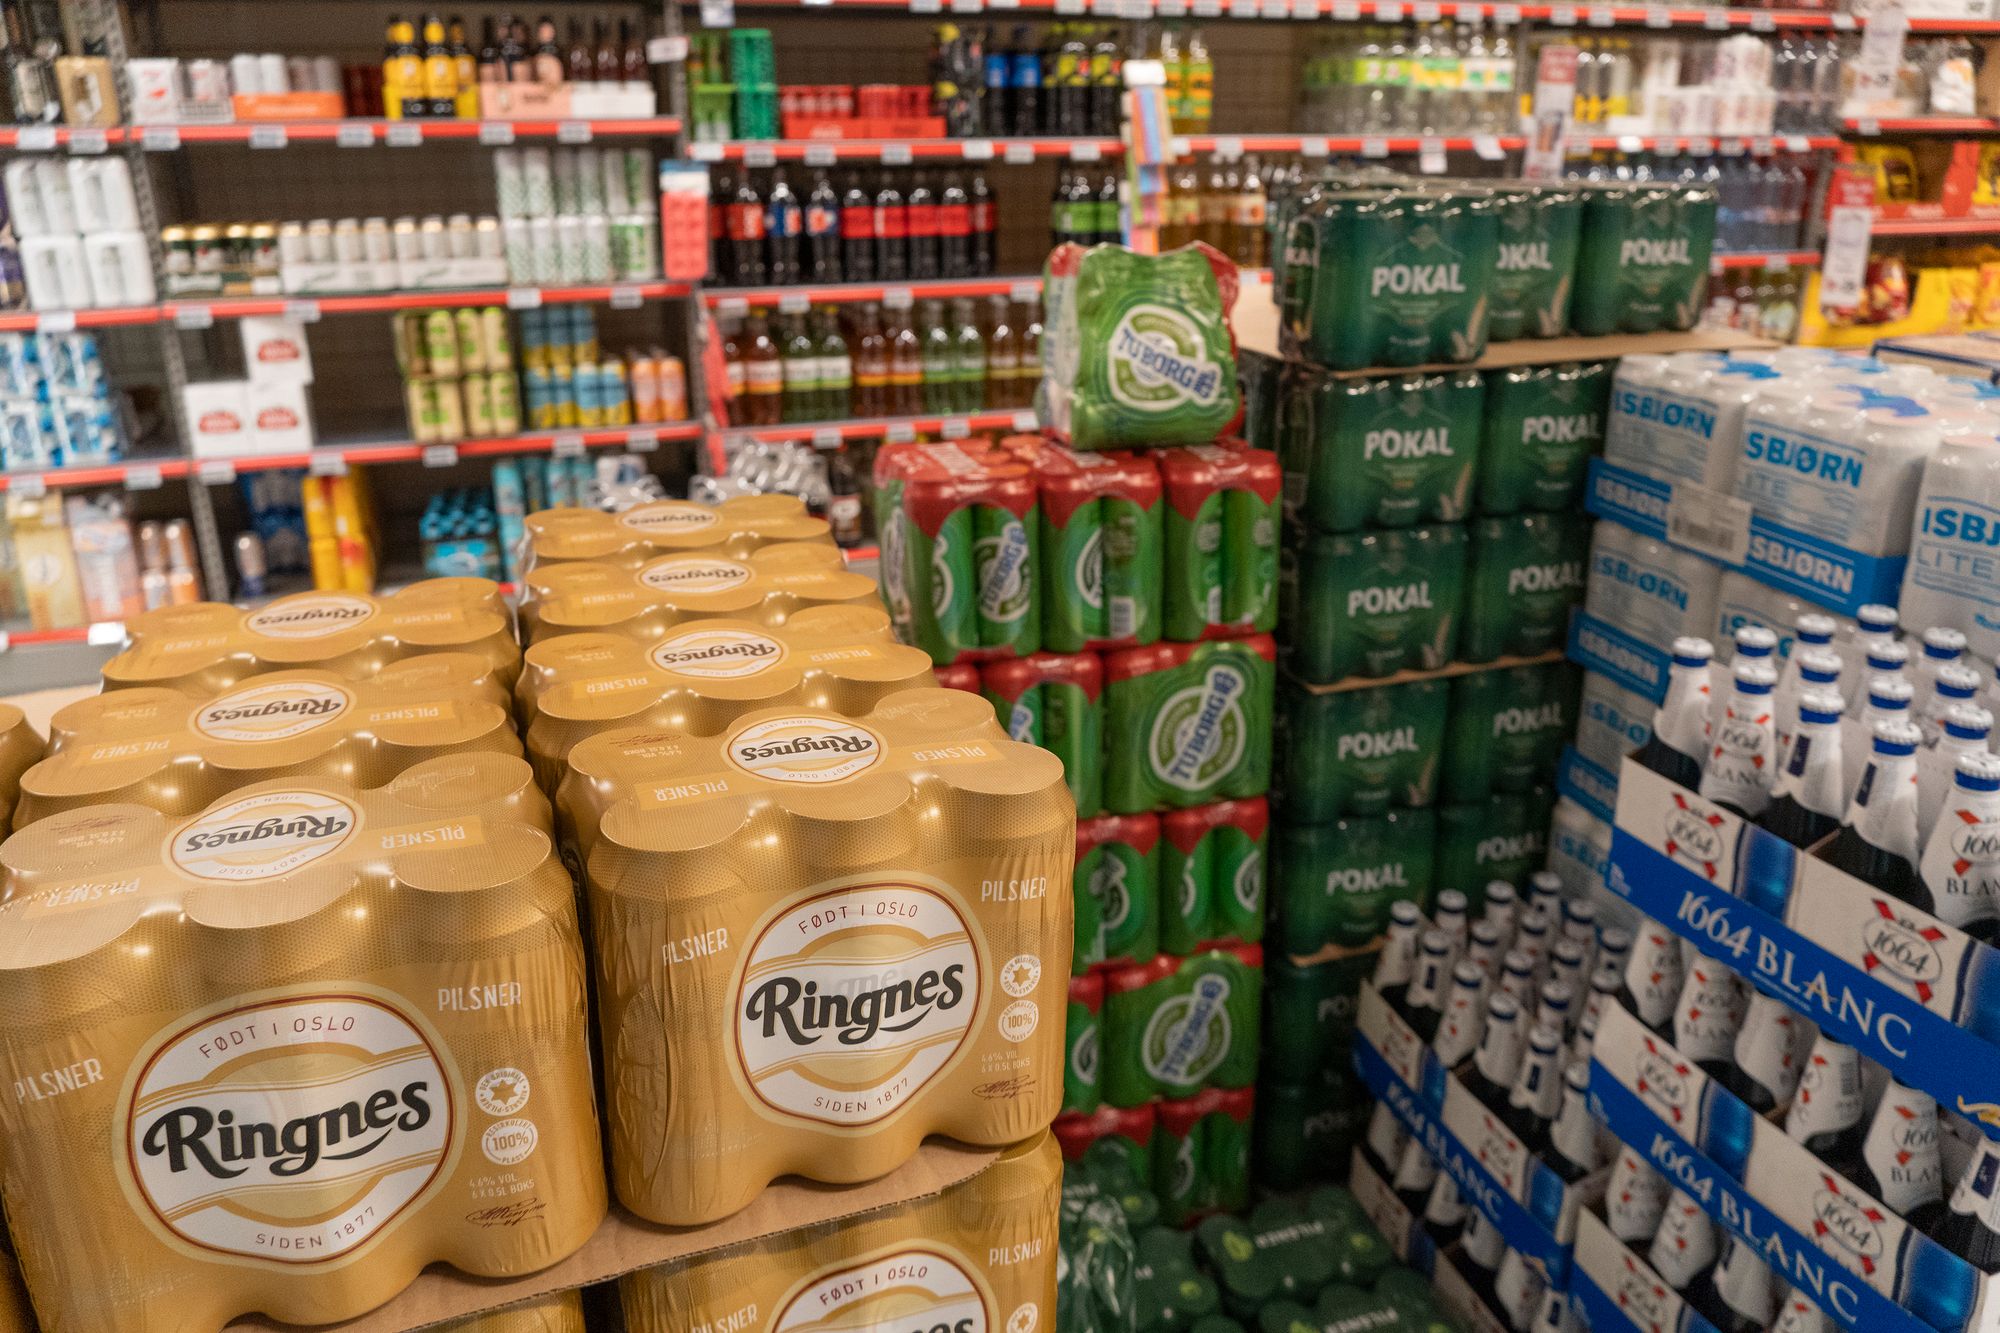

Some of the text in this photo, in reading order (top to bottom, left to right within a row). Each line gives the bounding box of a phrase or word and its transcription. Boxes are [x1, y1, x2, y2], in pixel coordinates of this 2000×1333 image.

[1620, 238, 1692, 267] POKAL
[1371, 262, 1467, 297] POKAL
[1118, 327, 1196, 388] TUBORG
[1522, 413, 1602, 445] POKAL
[1615, 391, 1716, 440] ISBJØRN
[1364, 427, 1454, 461] POKAL
[1922, 507, 2000, 547] ISBJ
[1509, 561, 1584, 594] POKAL
[1916, 546, 1995, 581] LITE
[1348, 580, 1433, 617] POKAL
[256, 606, 368, 626] Ringnes
[664, 643, 776, 664] Ringnes
[811, 648, 873, 663] PILSNER
[587, 677, 649, 693] PILSNER
[208, 698, 343, 724] Ringnes
[370, 706, 439, 722] PILSNER
[1493, 702, 1563, 736] POKAL
[91, 739, 170, 761] PILSNER
[741, 735, 872, 762] Ringnes
[912, 744, 987, 762] PILSNER
[1168, 691, 1228, 782] TUBORG
[1338, 725, 1420, 760] POKAL
[654, 779, 729, 802] PILSNER
[186, 815, 347, 852] Ringnes
[381, 825, 465, 849] PILSNER
[1476, 829, 1544, 863] POKAL
[46, 877, 141, 908] PILSNER
[981, 877, 1047, 902] PILSNER
[1327, 863, 1408, 895] POKAL
[798, 901, 919, 935] FØDT I OSLO
[662, 928, 729, 966] PILSNER
[1874, 931, 1929, 974] 1664
[1677, 888, 1752, 958] 1664
[1756, 934, 1913, 1060] BLANC
[437, 981, 522, 1012] PILSNER
[746, 963, 964, 1046] Ringnes
[199, 1015, 356, 1059] FØDT I OSLO
[1007, 1013, 1033, 1029] 100%
[14, 1057, 104, 1104] PILSNER
[812, 1077, 910, 1114] SIDEN 1877
[142, 1080, 432, 1180] Ringnes
[492, 1132, 529, 1151] 100%
[510, 1179, 535, 1194] BOKS
[1426, 1122, 1503, 1221] BLANC
[254, 1205, 378, 1250] SIDEN 1877
[1651, 1132, 1859, 1325] 1664 BLANC
[1824, 1202, 1871, 1247] 1664
[989, 1240, 1043, 1267] PILSNER
[819, 1266, 929, 1306] FØDT I OSLO
